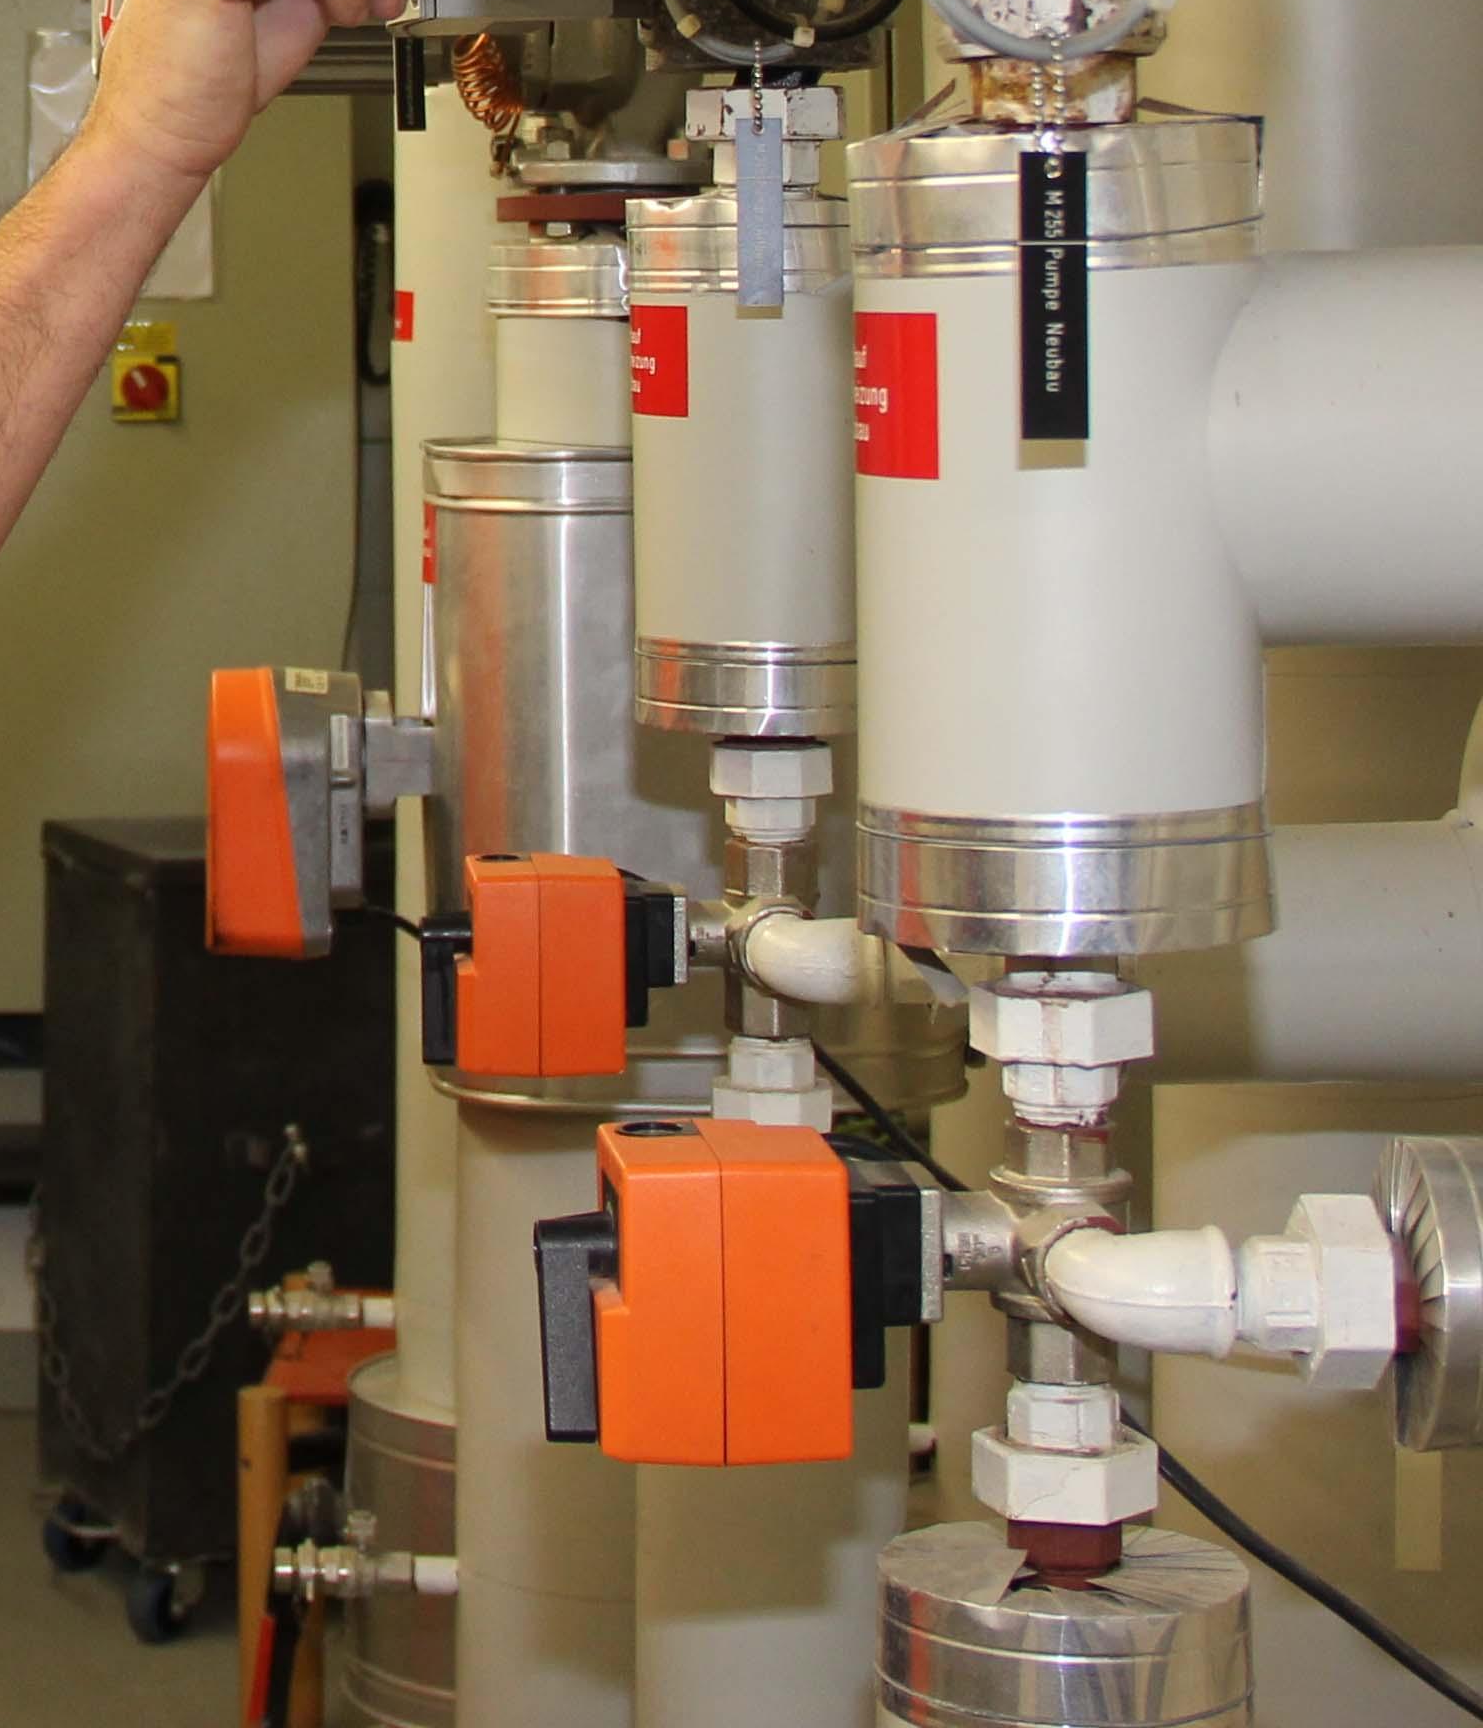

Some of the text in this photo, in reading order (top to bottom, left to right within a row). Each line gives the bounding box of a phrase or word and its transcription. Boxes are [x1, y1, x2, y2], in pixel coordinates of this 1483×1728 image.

[1041, 191, 1065, 393] M 255 Pumpe Neubau
